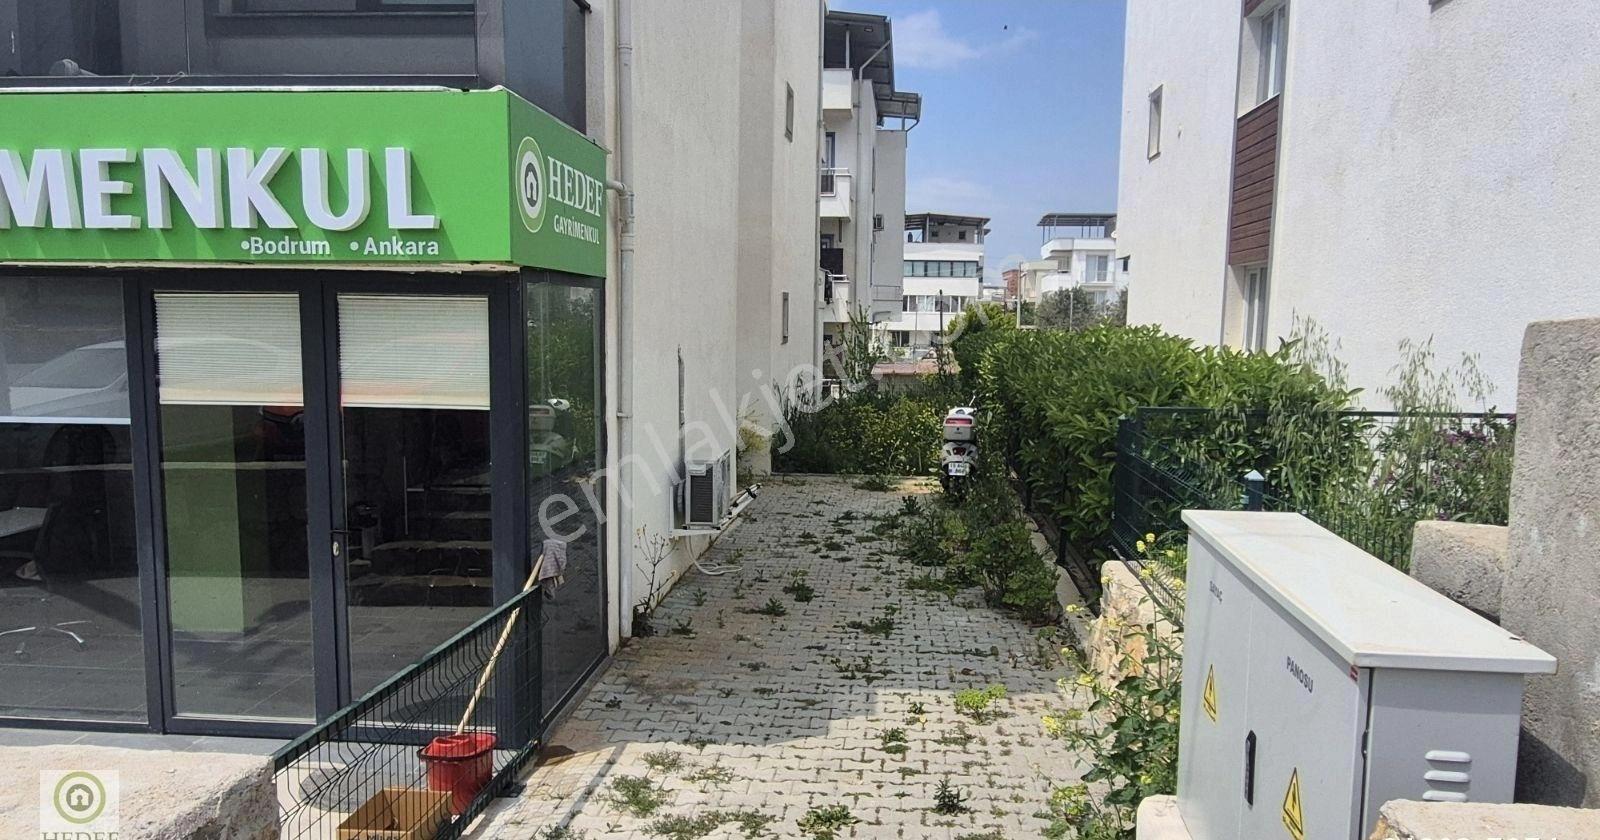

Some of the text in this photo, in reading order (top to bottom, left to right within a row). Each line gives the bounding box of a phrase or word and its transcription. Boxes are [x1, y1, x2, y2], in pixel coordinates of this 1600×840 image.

[0, 147, 440, 231] MENKUL
[548, 155, 604, 217] HEDEF
[250, 236, 439, 255] Bodrum Ankara
[553, 214, 600, 244] GAYRİMENKUL
[1286, 655, 1314, 694] PANOSU
